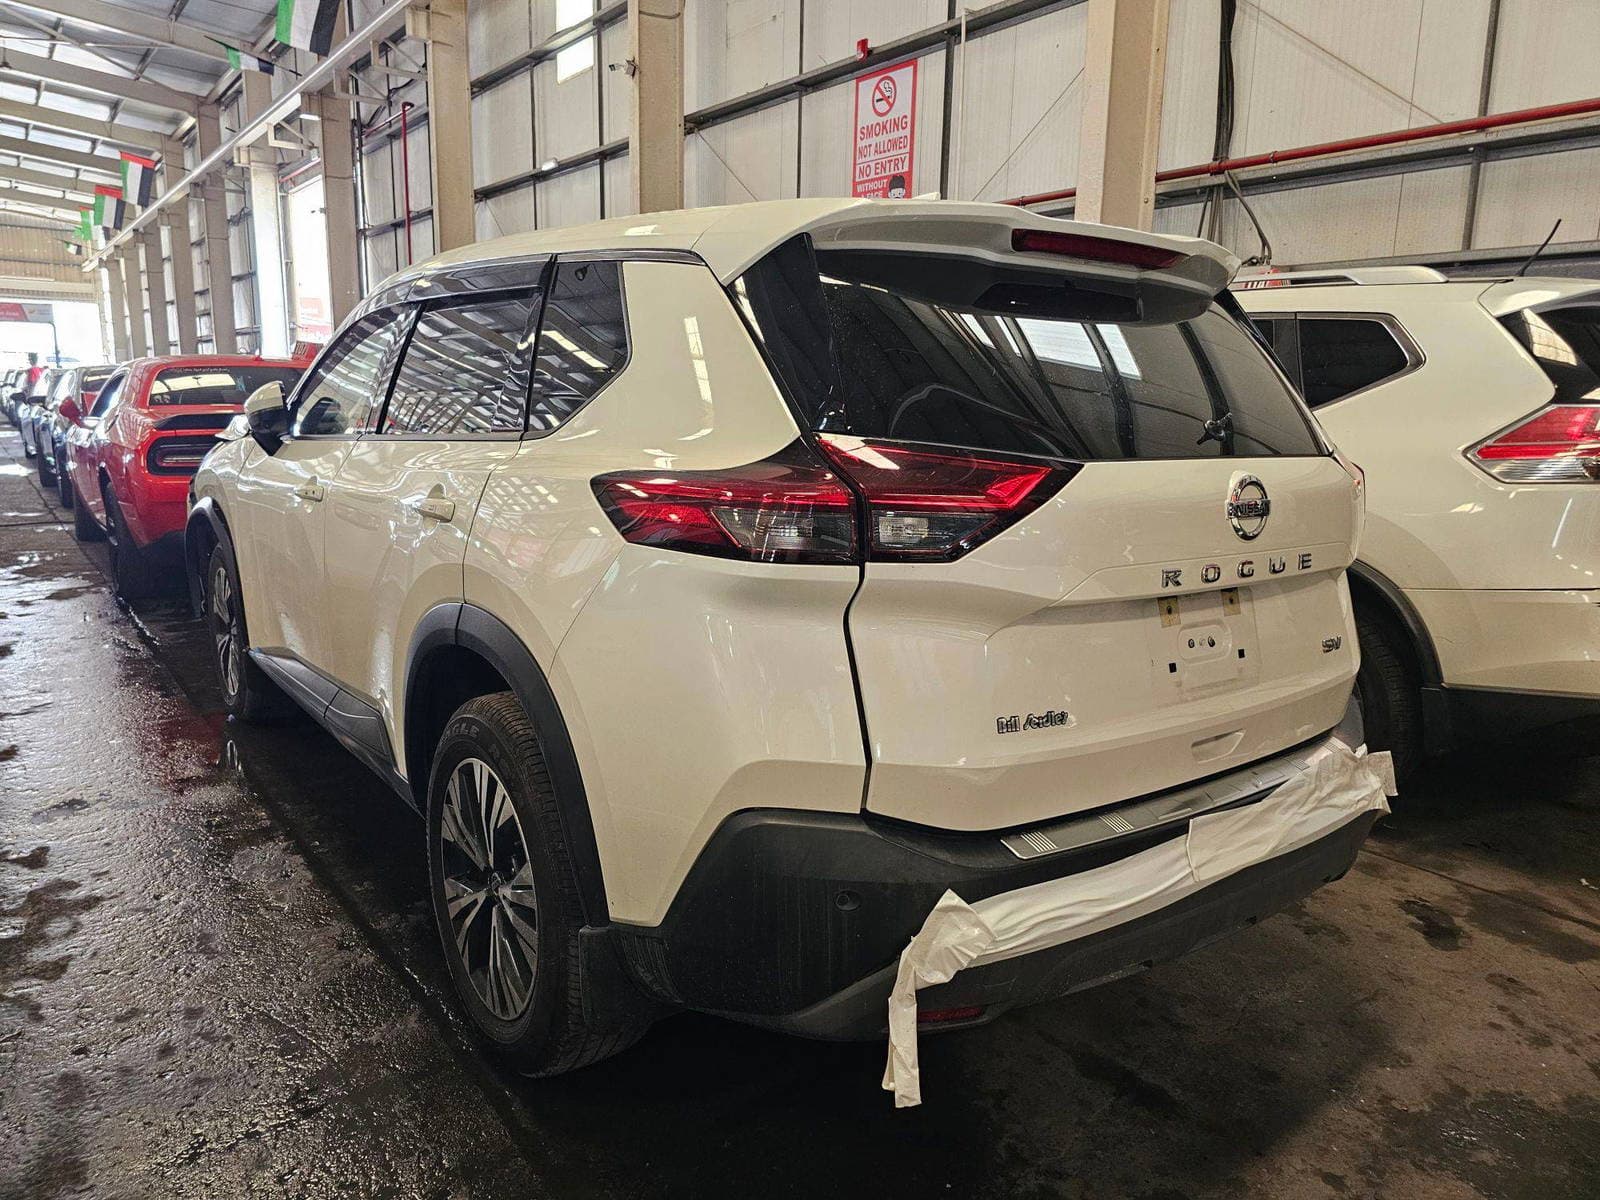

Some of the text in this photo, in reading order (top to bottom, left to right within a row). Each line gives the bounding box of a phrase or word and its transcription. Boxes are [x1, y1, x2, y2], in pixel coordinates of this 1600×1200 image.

[859, 115, 908, 141] SMOKING
[858, 135, 908, 160] NOT ALLOWED
[858, 155, 907, 180] NO ENTRY
[856, 179, 888, 193] WITHOUT
[1161, 553, 1312, 588] ROGUE
[1321, 635, 1342, 653] SV
[996, 715, 1020, 734] Bill
